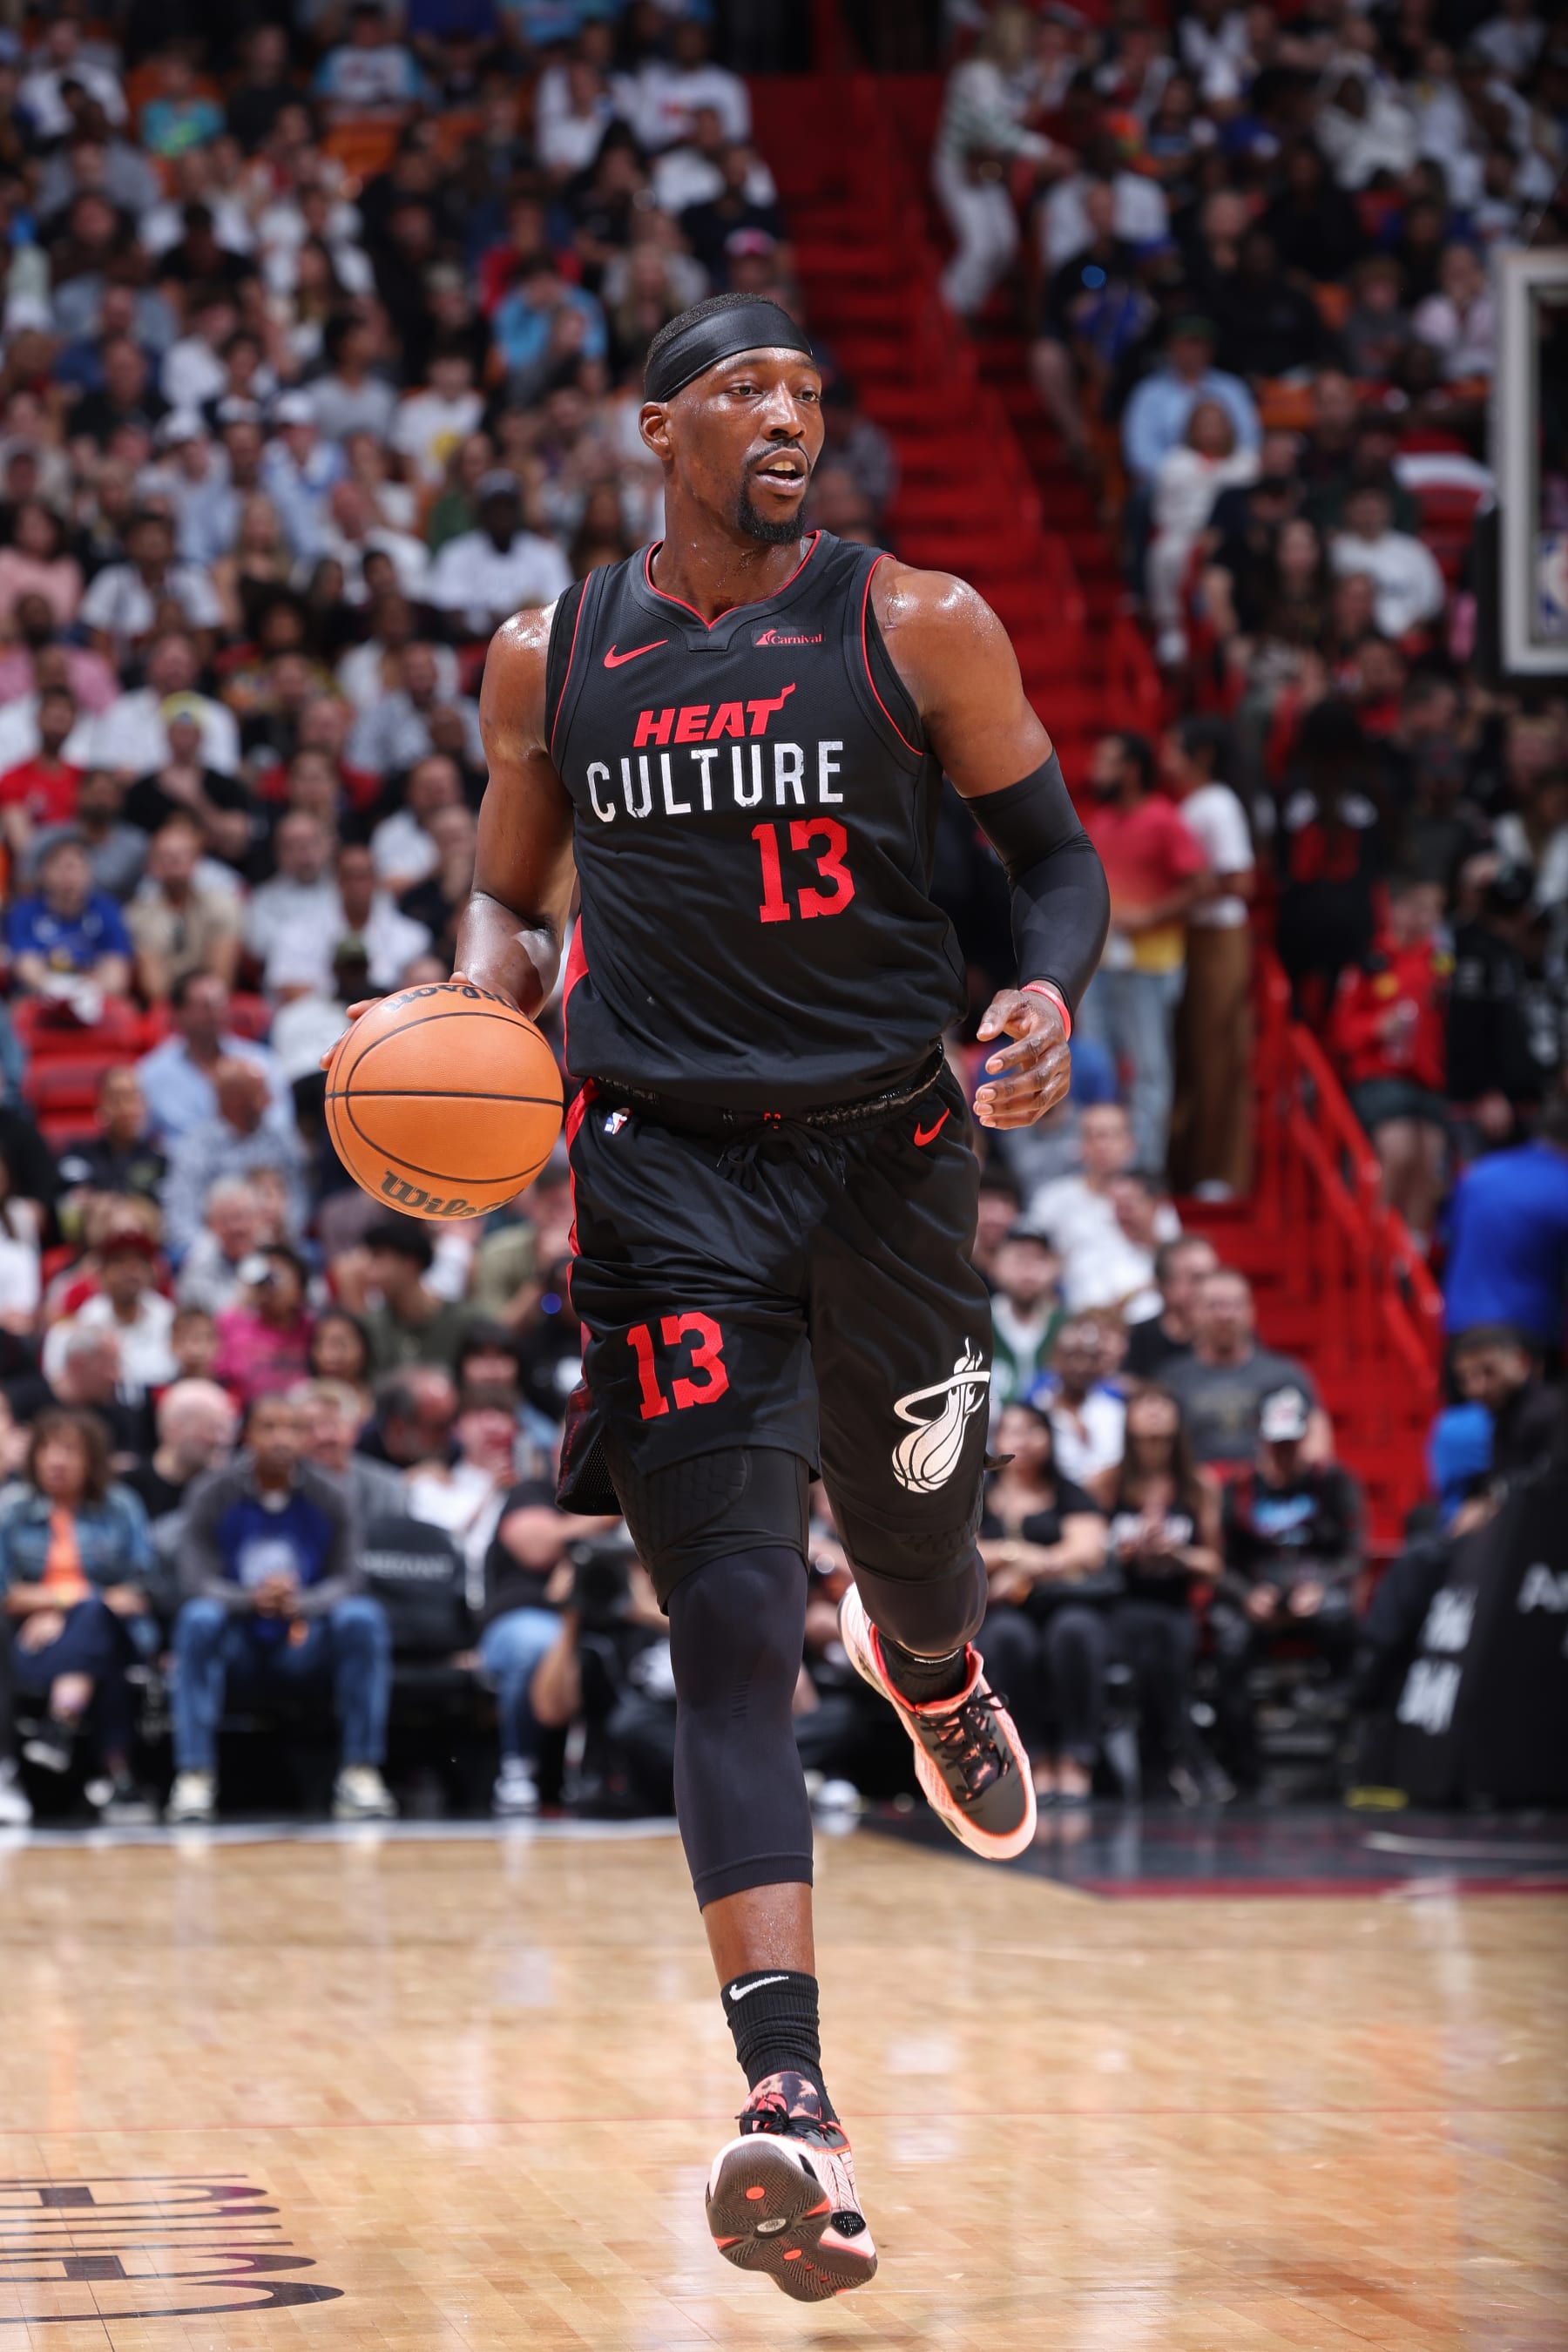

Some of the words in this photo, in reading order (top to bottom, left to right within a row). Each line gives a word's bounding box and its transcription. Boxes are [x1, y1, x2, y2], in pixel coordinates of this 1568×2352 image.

[770, 632, 822, 645] Carnival
[632, 683, 796, 748] HEAT
[585, 740, 844, 823] CULTURE
[751, 817, 855, 923] 13
[626, 1311, 730, 1420] 13
